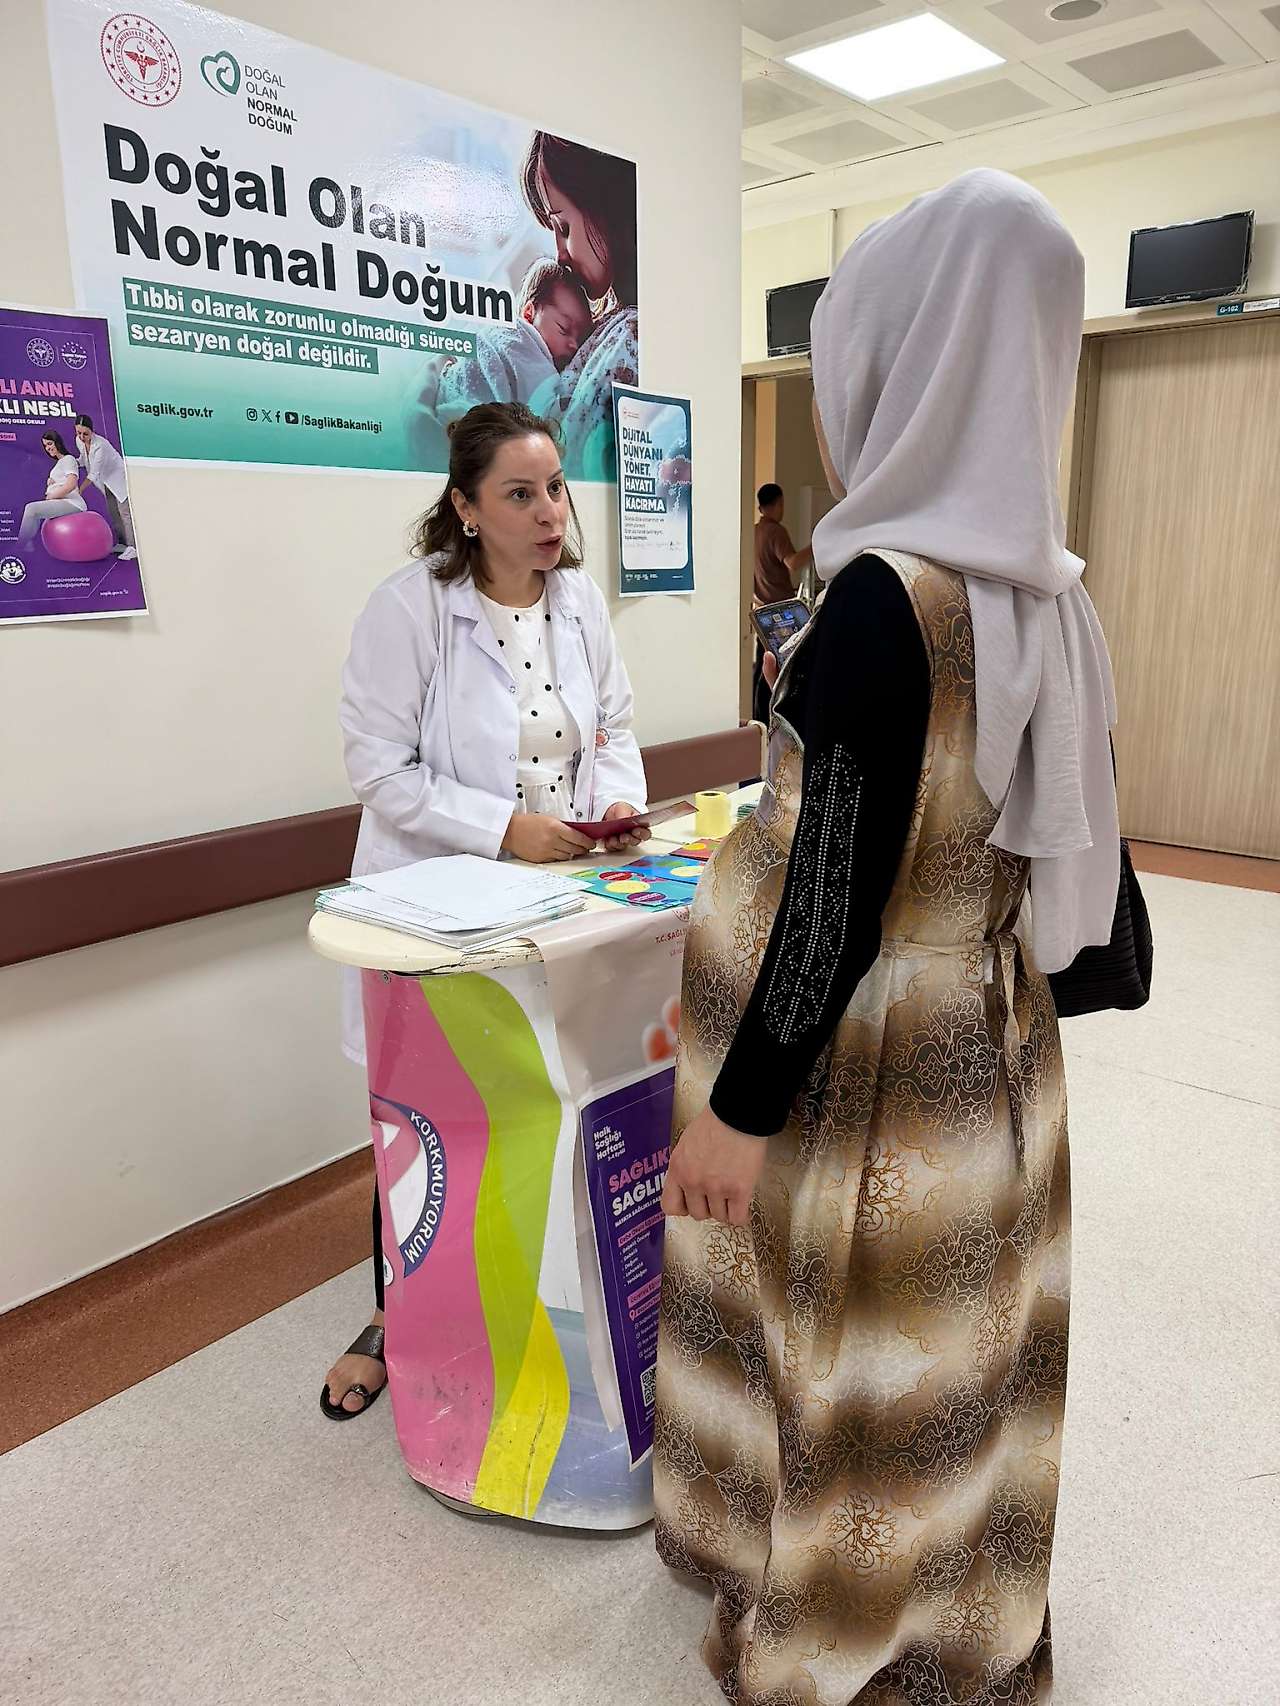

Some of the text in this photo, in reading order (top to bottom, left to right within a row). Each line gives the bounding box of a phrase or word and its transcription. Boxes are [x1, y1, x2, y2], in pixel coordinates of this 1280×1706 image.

[244, 65, 286, 88] DOĞAL
[246, 82, 278, 100] OLAN
[247, 97, 298, 122] NORMAL
[248, 113, 293, 135] DOĞUM
[103, 122, 426, 249] Doğal Olan
[110, 198, 513, 322] Normal Doğum
[125, 282, 473, 354] Tıbbi olarak zorunlu olmadığı sürece
[130, 323, 372, 369] sezaryen doğal değildir.
[0, 378, 75, 398] LI ANNE
[23, 400, 77, 418] NESİL
[137, 402, 214, 419] saglik.gov.tr
[623, 441, 663, 460] DÜNYANI
[625, 477, 653, 493] HAYATI
[593, 1125, 611, 1141] Halk
[594, 1129, 622, 1150] Sağlığı
[596, 1140, 625, 1161] Haftası
[608, 1146, 671, 1194] SAĞLIK
[404, 1111, 444, 1265] KORKMUYORUM
